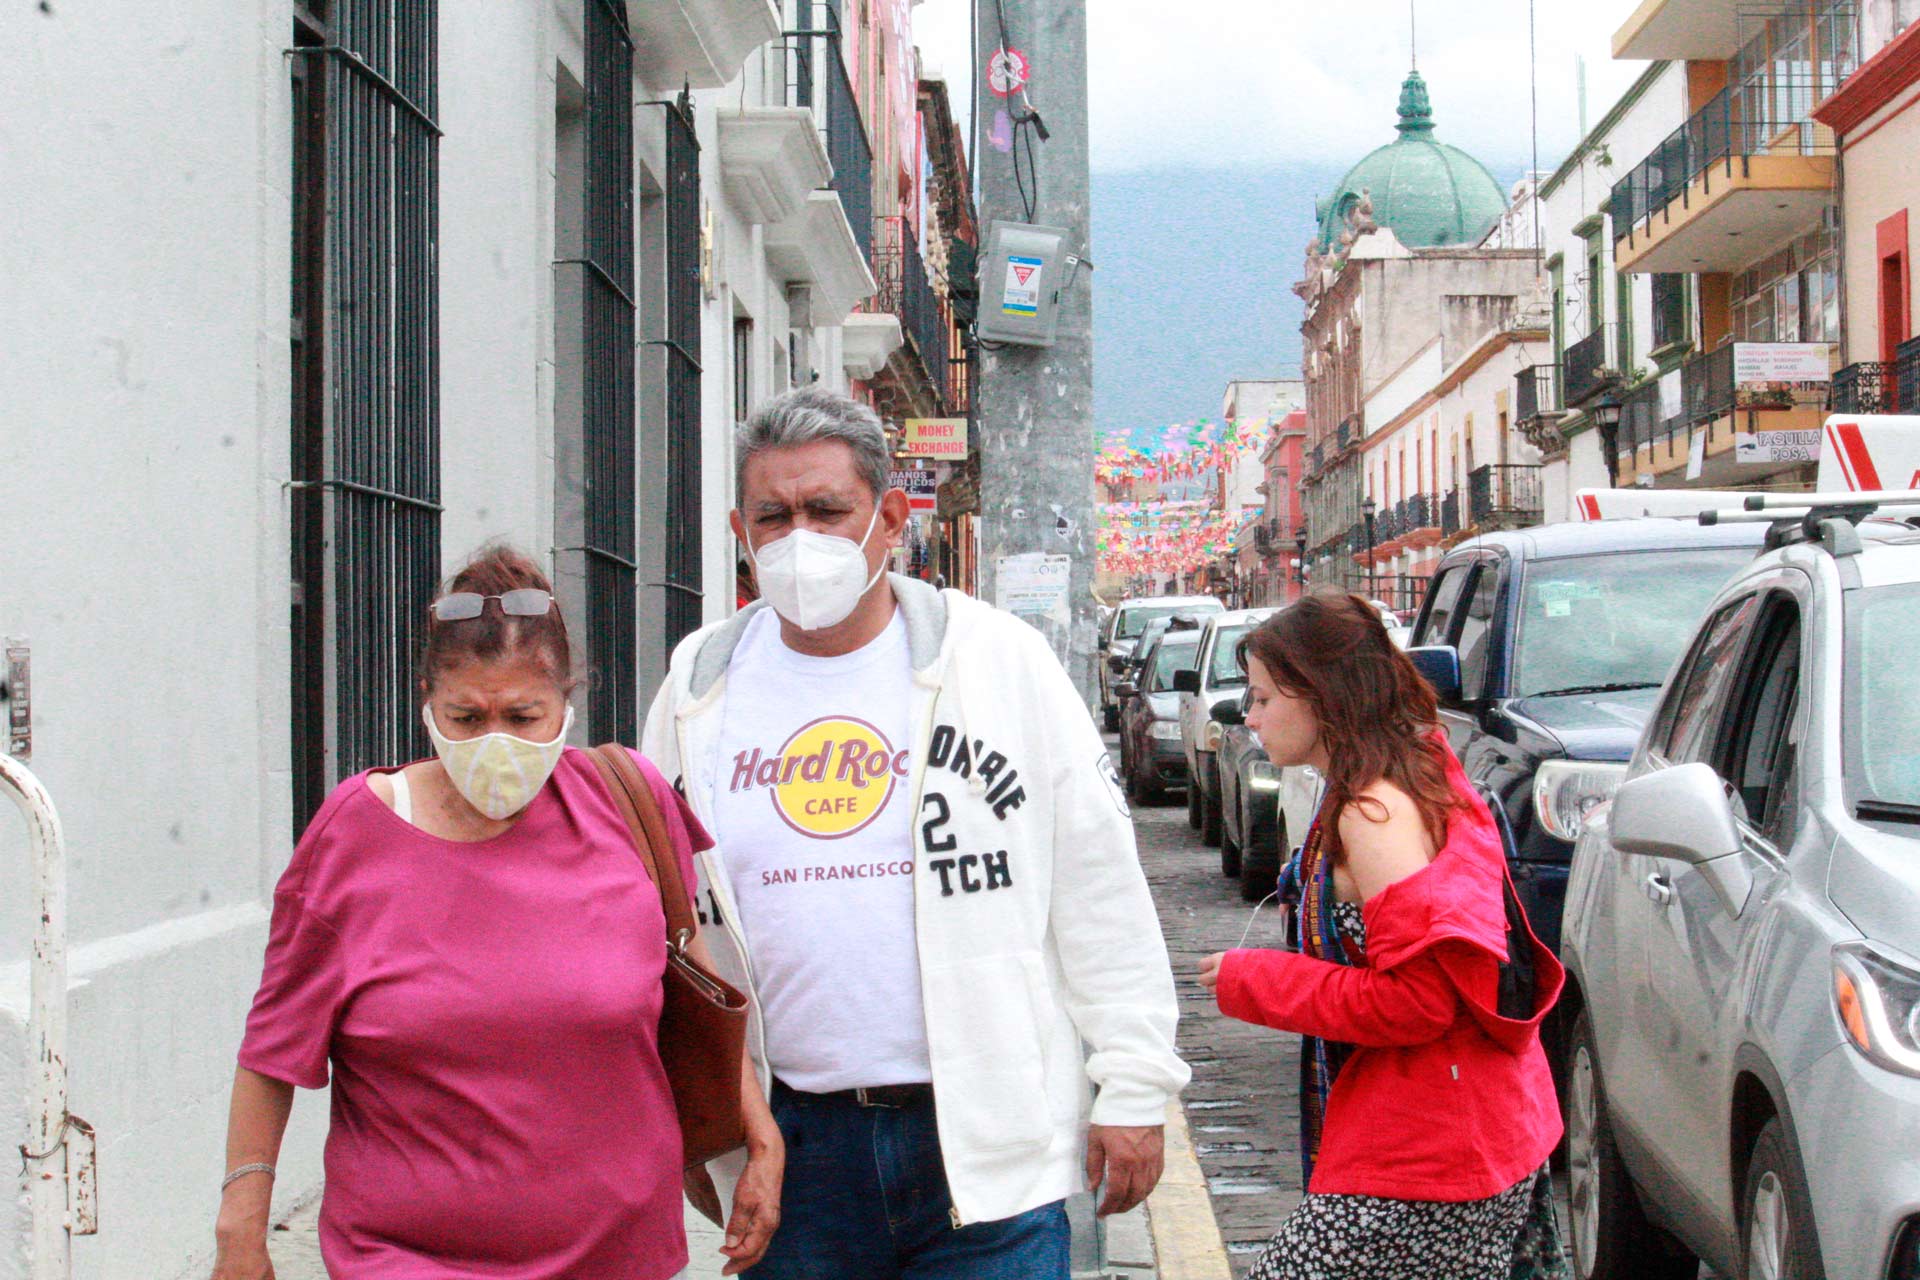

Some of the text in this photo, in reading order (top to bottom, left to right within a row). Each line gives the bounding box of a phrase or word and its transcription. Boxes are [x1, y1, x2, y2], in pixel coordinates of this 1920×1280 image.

[918, 424, 955, 437] MONEY
[1757, 431, 1821, 447] TAQUILLA
[908, 442, 964, 454] EXCHANGE
[1771, 447, 1809, 461] ROSA
[729, 740, 834, 793] Hard
[805, 797, 857, 815] CAFE
[762, 861, 914, 885] SAN FRANCISCO
[930, 850, 1012, 897] TCH
